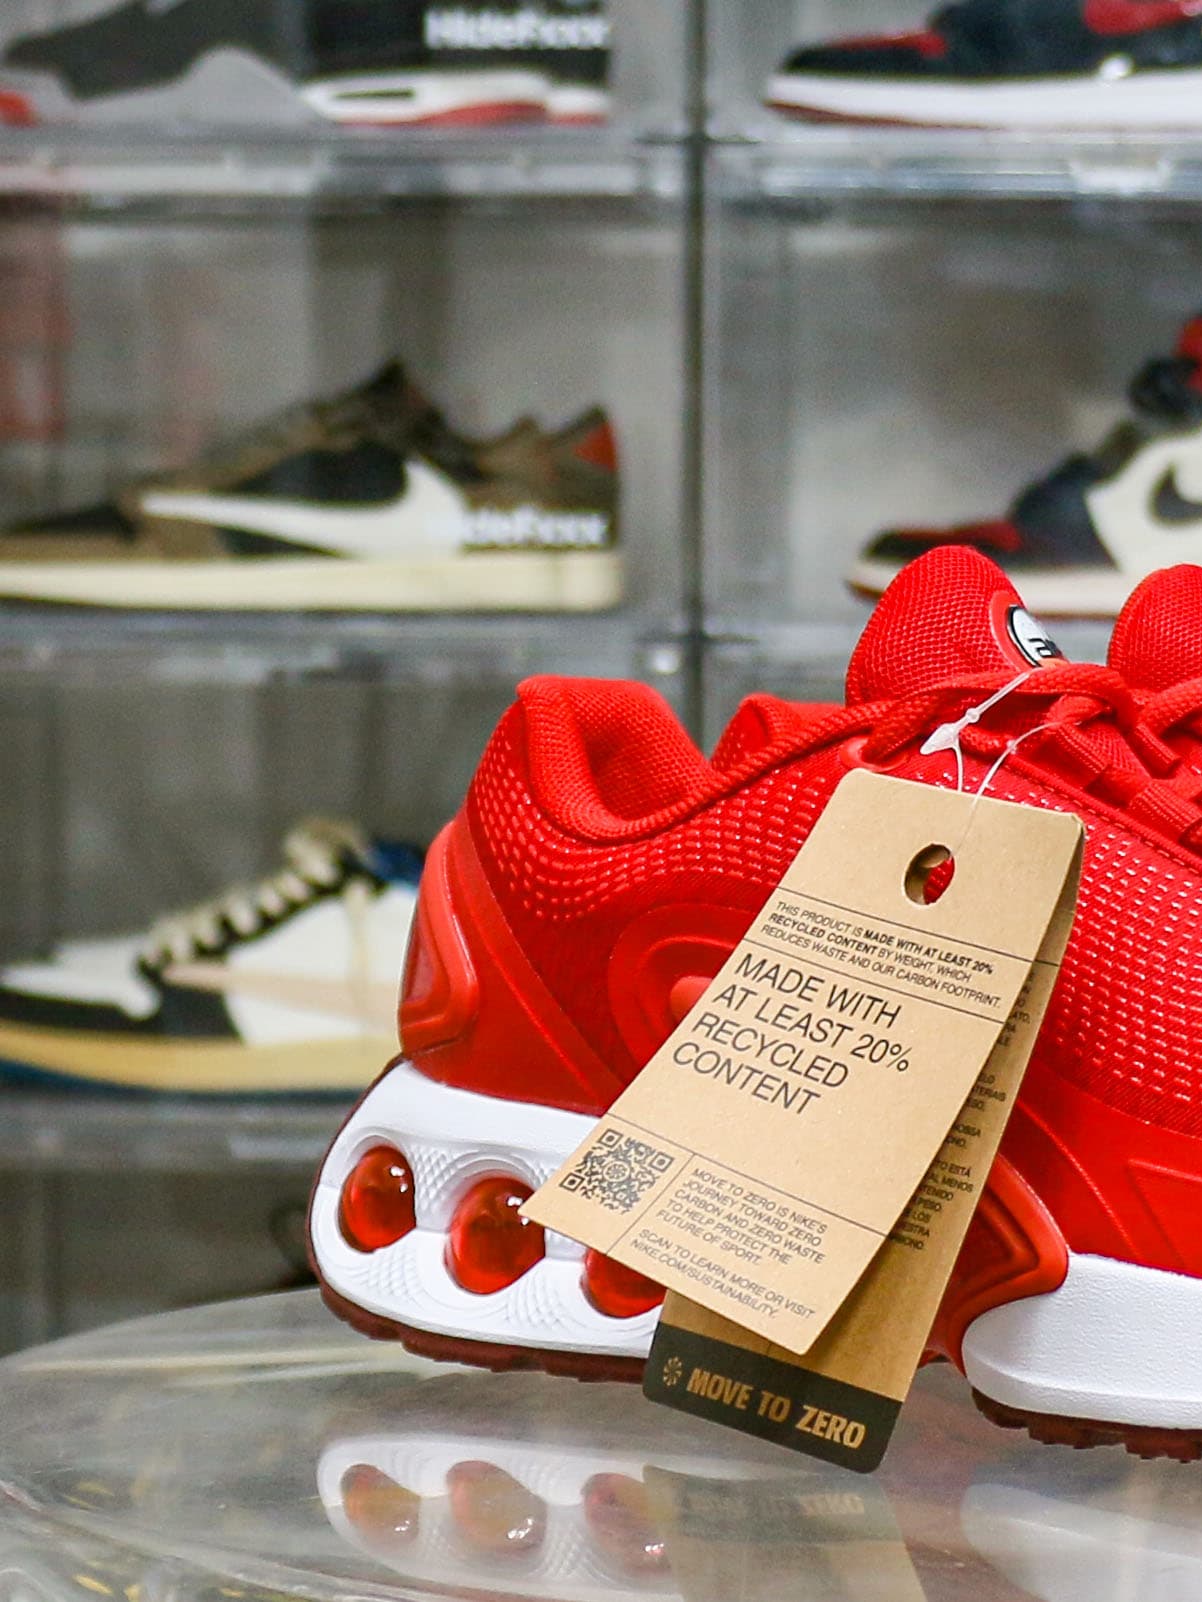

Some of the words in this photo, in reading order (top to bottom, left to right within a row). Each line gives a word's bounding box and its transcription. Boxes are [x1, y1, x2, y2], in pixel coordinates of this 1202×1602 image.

[760, 924, 811, 949] REDUCES
[811, 941, 849, 961] WASTE
[848, 955, 871, 968] AND
[871, 961, 895, 975] OUR
[896, 969, 940, 989] CARBON
[941, 981, 1001, 1008] FOOTPRINT.
[769, 913, 826, 938] RECYCLED
[827, 932, 878, 955] CONTENT
[878, 948, 895, 960] BY
[936, 965, 972, 983] WHICH
[776, 901, 800, 916] THIS
[800, 910, 852, 933] PRODUCT
[852, 926, 864, 938] IS
[863, 929, 895, 946] MADE
[896, 938, 923, 954] WITH
[923, 947, 938, 957] AT
[938, 951, 973, 968] LEAST
[972, 960, 993, 975] 20%
[712, 983, 757, 1012] AT
[754, 997, 853, 1049] LEAST
[850, 1033, 913, 1073] 20%
[734, 953, 825, 1002] MADE
[826, 983, 902, 1029] WITH
[672, 1041, 821, 1114] CONTENT
[692, 1011, 849, 1088] RECYCLED
[656, 1209, 704, 1238] FUTURE
[702, 1232, 722, 1245] OF
[720, 1240, 762, 1266] SPORT.
[666, 1199, 683, 1213] TO
[683, 1208, 715, 1226] HELP
[713, 1222, 769, 1253] PROTECT
[768, 1247, 793, 1265] THE
[674, 1189, 724, 1216] CARBON
[723, 1212, 749, 1229] AND
[748, 1223, 783, 1244] ZERO
[783, 1238, 826, 1264] WASTE
[682, 1180, 738, 1209] JOURNEY
[739, 1203, 788, 1232] TOWARD
[788, 1226, 822, 1247] ZERO
[691, 1168, 728, 1187] MOVE
[727, 1183, 744, 1197] TO
[743, 1191, 777, 1211] ZERO
[776, 1205, 789, 1218] IS
[789, 1211, 828, 1234] NIKE'S
[630, 1239, 781, 1319] NIKE.COM/SUSTAINABILITY.
[638, 1229, 673, 1250] SCAN
[673, 1245, 691, 1259] TO
[690, 1253, 730, 1279] LEARN
[729, 1273, 767, 1297] MORE
[764, 1290, 785, 1306] OR
[784, 1299, 816, 1319] VISIT
[686, 1367, 754, 1411] MOVE
[756, 1390, 793, 1423] TO
[795, 1404, 867, 1449] ZERO
